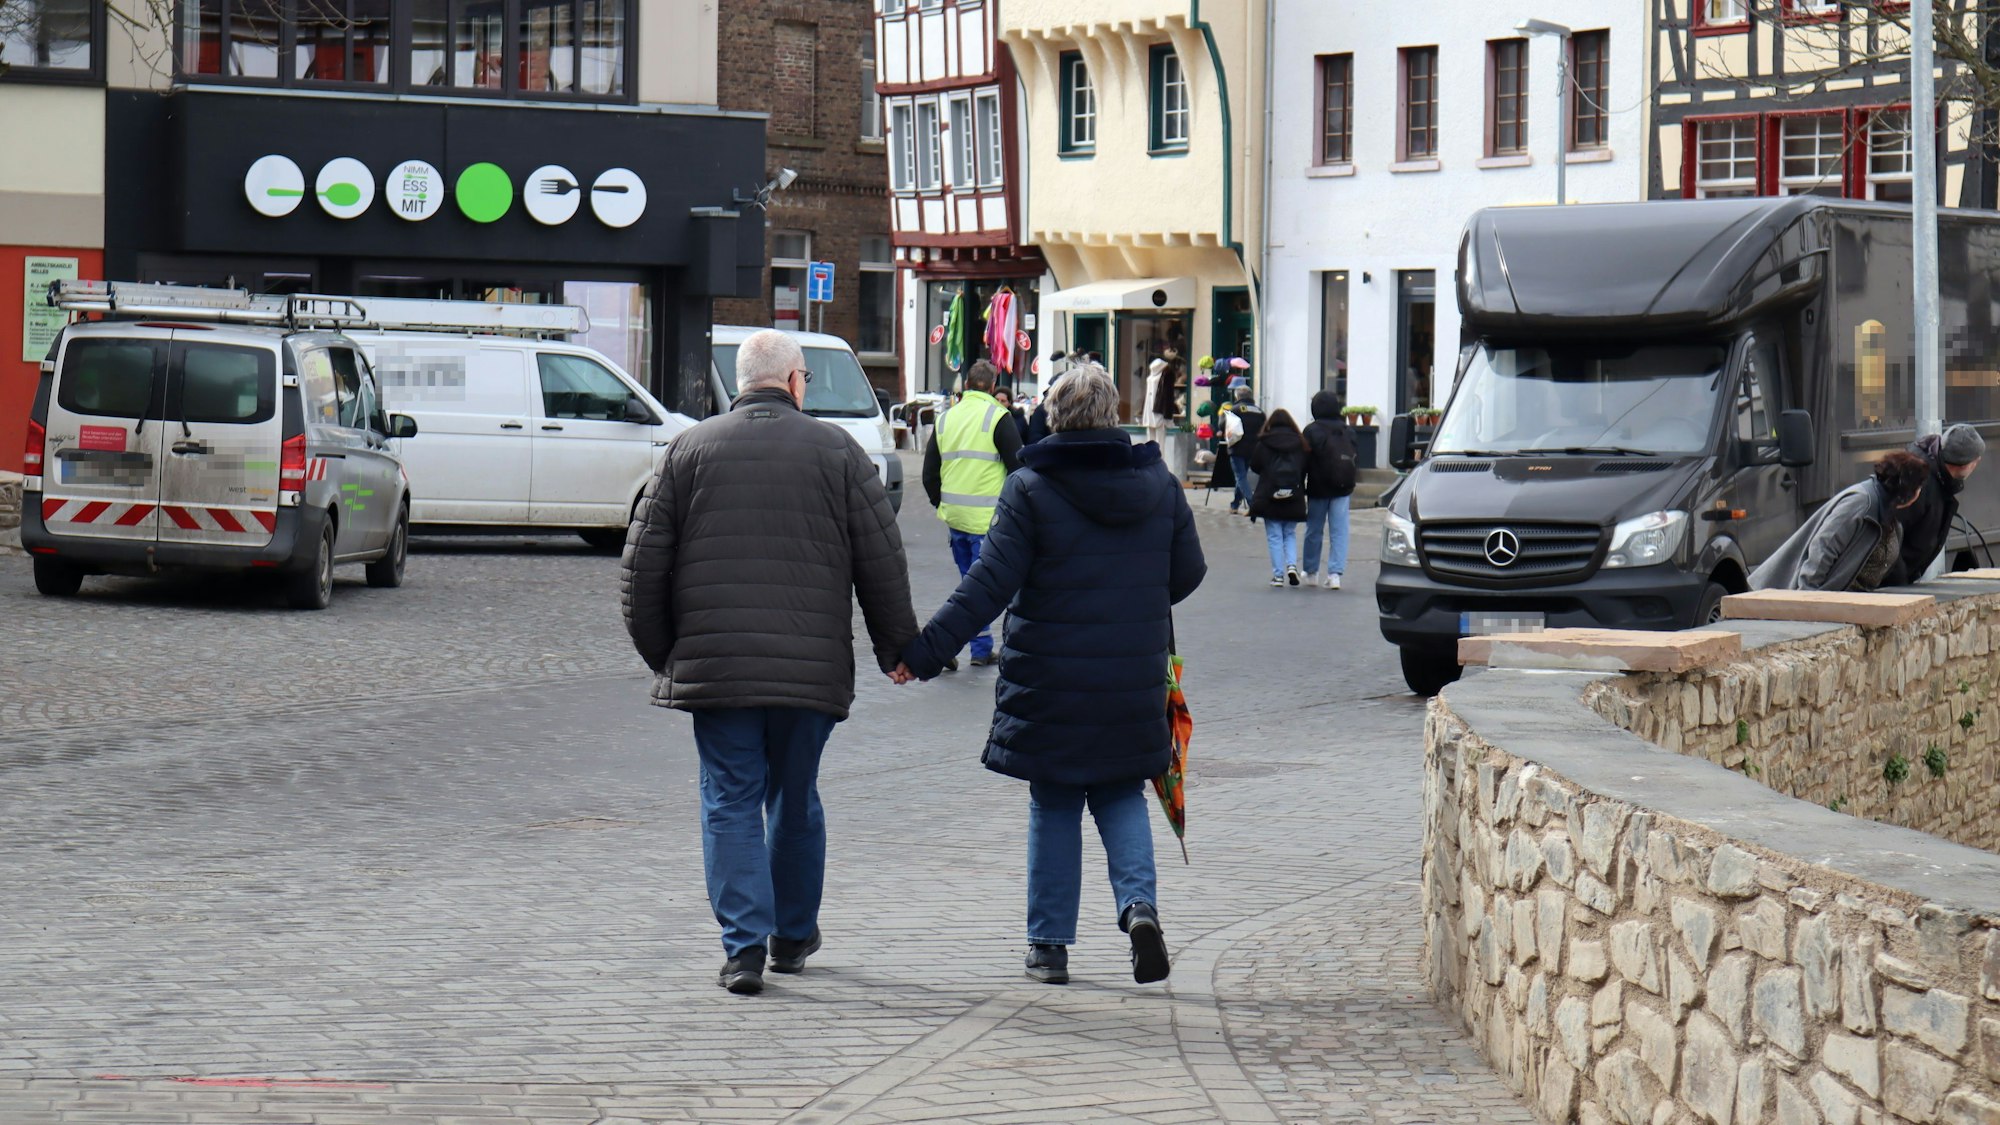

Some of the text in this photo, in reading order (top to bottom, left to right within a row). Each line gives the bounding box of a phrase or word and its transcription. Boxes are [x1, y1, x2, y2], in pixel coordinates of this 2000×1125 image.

[403, 165, 429, 174] NIMM
[402, 180, 428, 192] ESS
[402, 199, 427, 213] MIT
